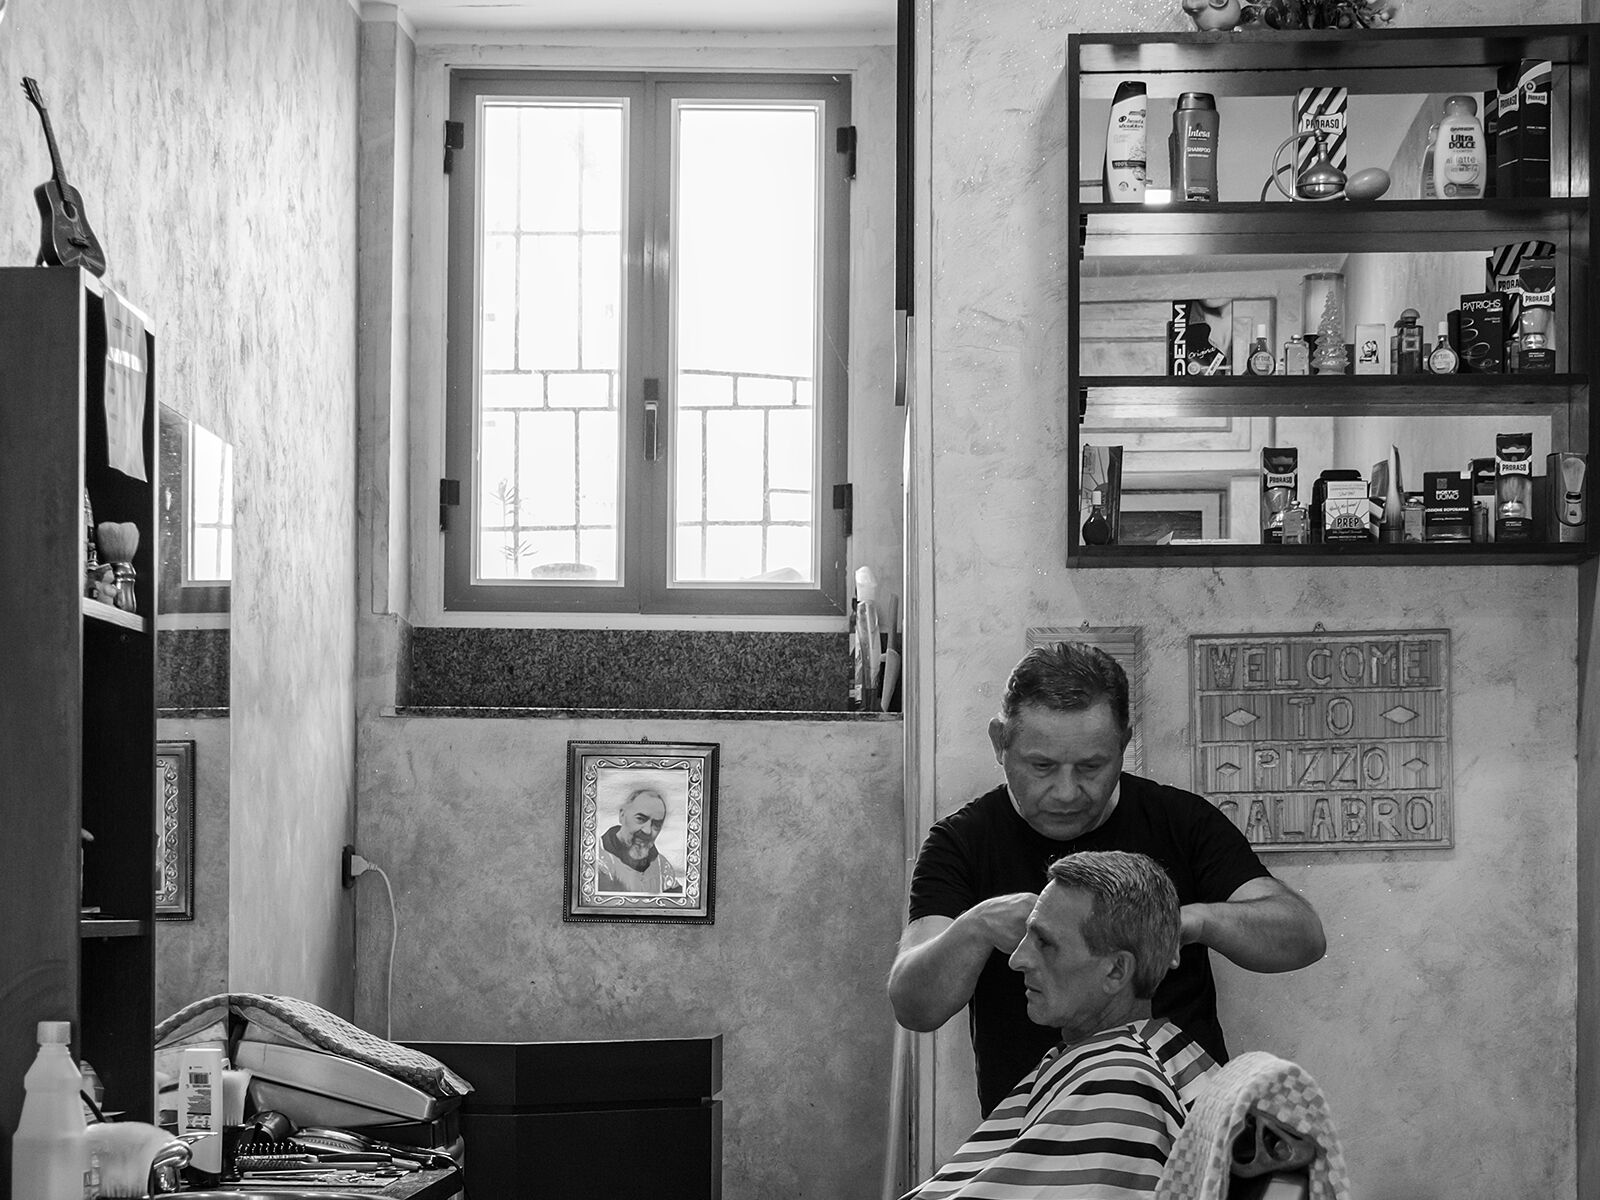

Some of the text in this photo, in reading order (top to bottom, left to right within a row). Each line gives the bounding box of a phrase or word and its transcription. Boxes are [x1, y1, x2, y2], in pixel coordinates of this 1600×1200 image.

[1188, 125, 1211, 138] Intesa
[1450, 134, 1474, 142] Ultra
[1448, 141, 1476, 149] DOLCE
[1497, 278, 1520, 291] PRORA
[1525, 294, 1550, 303] PRORASO
[1462, 299, 1501, 312] PATRICHS
[1174, 304, 1186, 376] DENIM
[1501, 463, 1527, 471] PRORASO
[1337, 517, 1360, 528] PREP
[1210, 644, 1429, 688] WELCOME
[1288, 696, 1355, 737] TO
[1254, 746, 1389, 789] PIZZO
